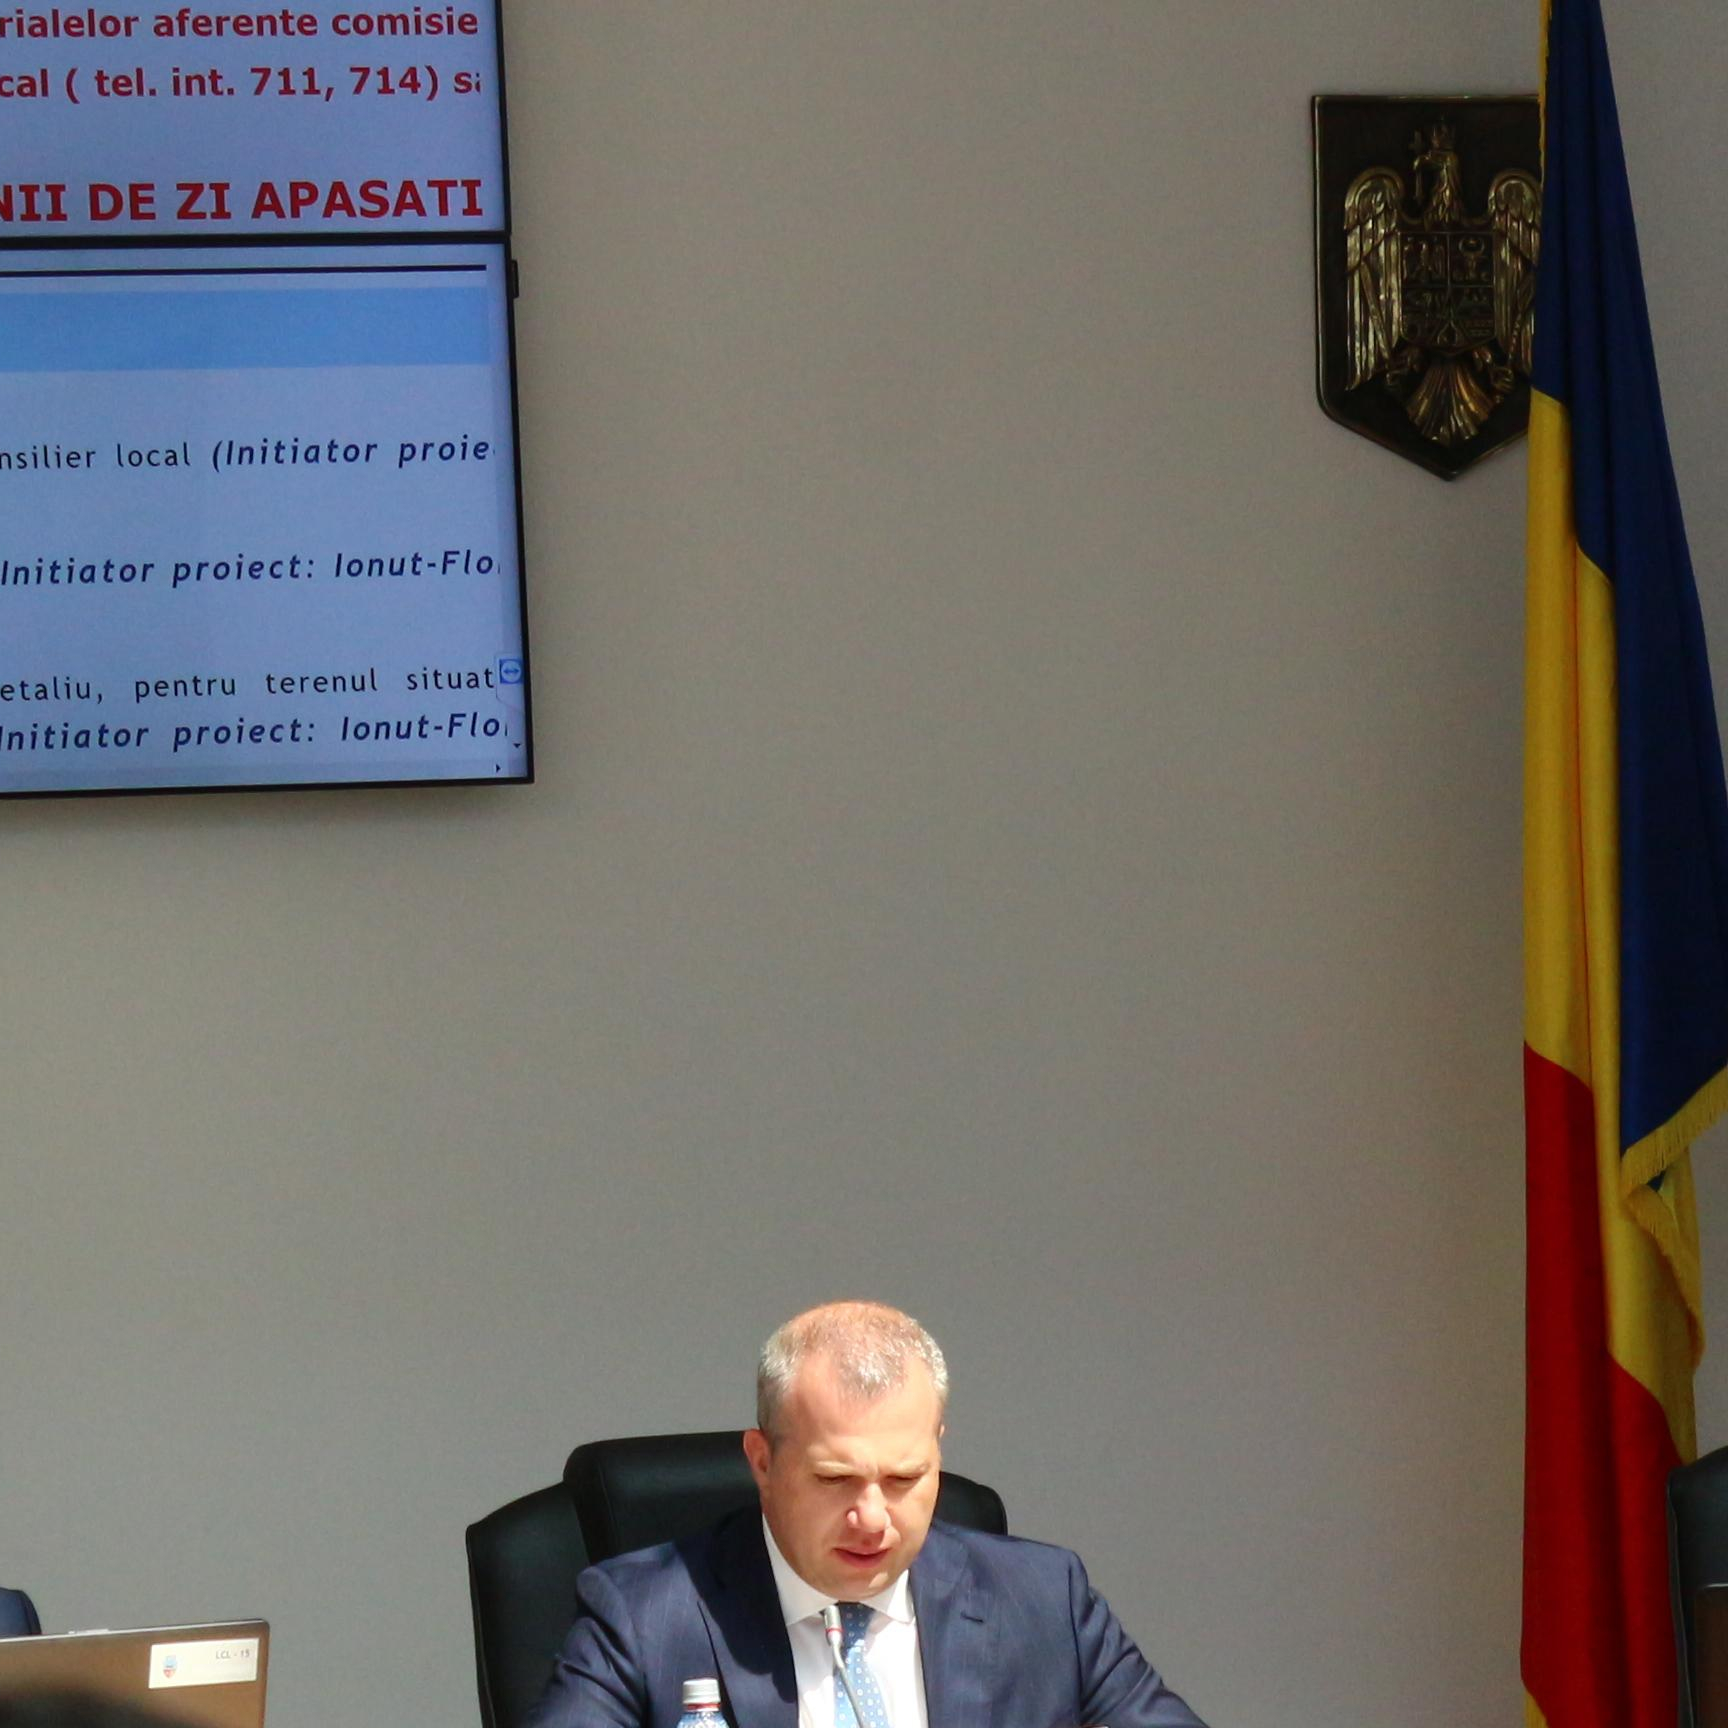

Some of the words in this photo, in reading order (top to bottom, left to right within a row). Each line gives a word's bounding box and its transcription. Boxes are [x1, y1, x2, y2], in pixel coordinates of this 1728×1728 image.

[153, 8, 317, 37] aferente
[332, 6, 478, 36] comisie
[66, 68, 80, 104] (
[94, 67, 156, 97] tel.
[172, 67, 234, 96] int.
[250, 67, 334, 102] 711,
[349, 65, 438, 101] 714)
[89, 183, 156, 221] DE
[176, 182, 231, 220] ZI
[251, 179, 482, 219] APASATI
[117, 442, 190, 468] local
[213, 437, 378, 473] (Initiator
[398, 434, 495, 469] proie
[172, 553, 314, 589] proiect:
[335, 549, 500, 578] Ionut-Flo
[135, 675, 235, 704] pentru
[266, 667, 378, 694] terenul
[407, 666, 494, 690] situat
[173, 717, 314, 753] proiect:
[342, 712, 507, 741] Ionut-Flo
